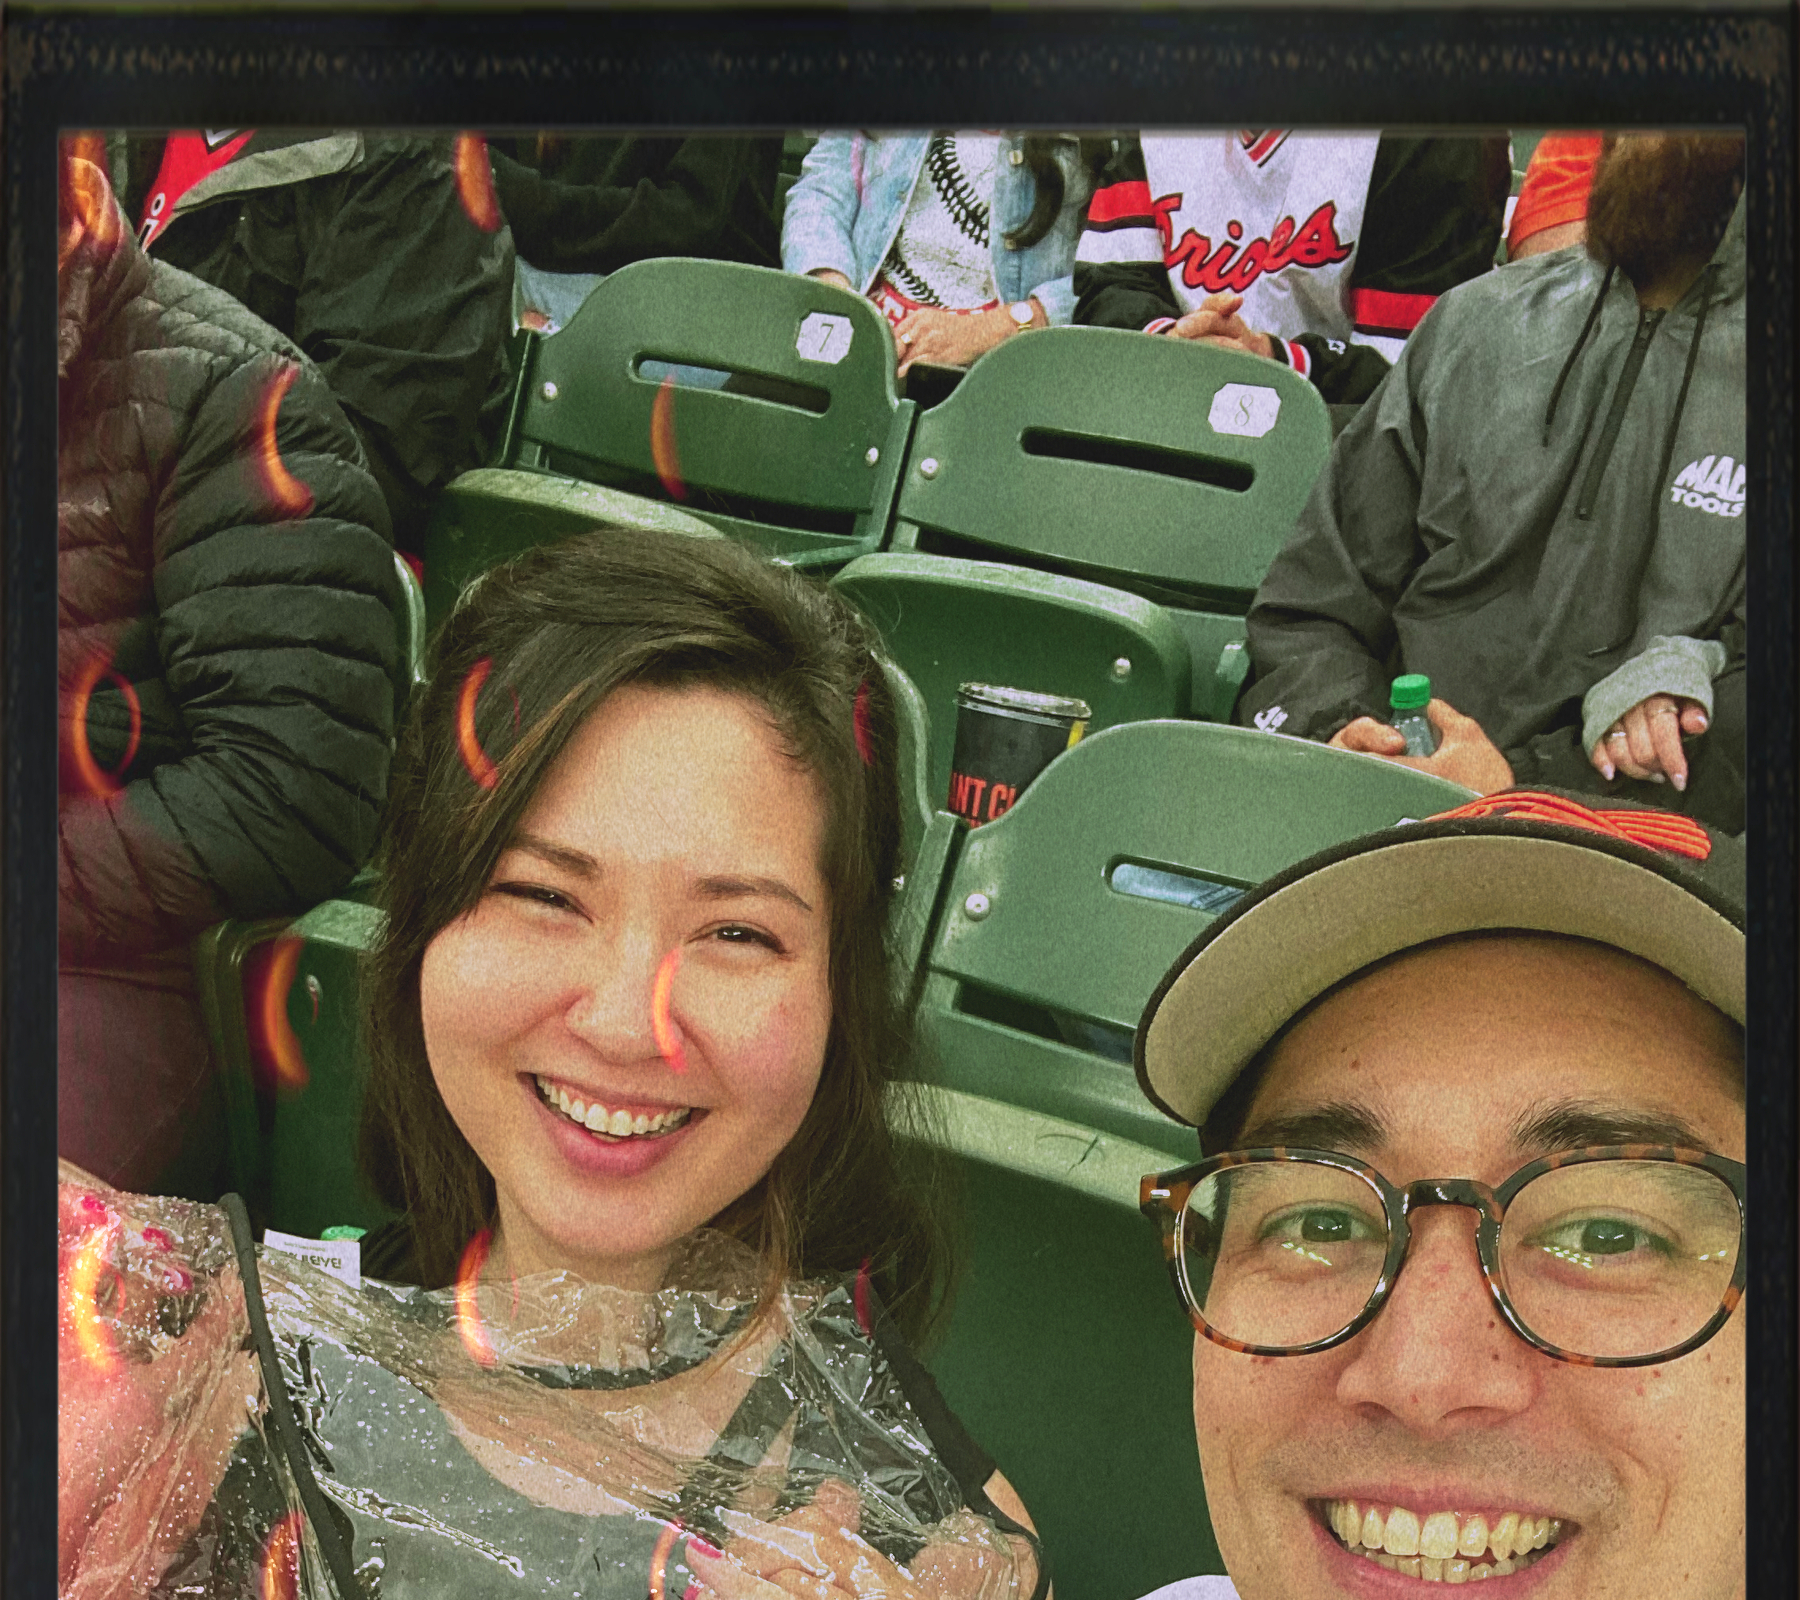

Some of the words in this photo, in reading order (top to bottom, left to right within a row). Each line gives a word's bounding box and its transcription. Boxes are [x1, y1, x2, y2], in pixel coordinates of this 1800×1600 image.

[819, 322, 834, 353] 7
[1235, 393, 1254, 427] 8
[1670, 486, 1746, 517] TOOLS
